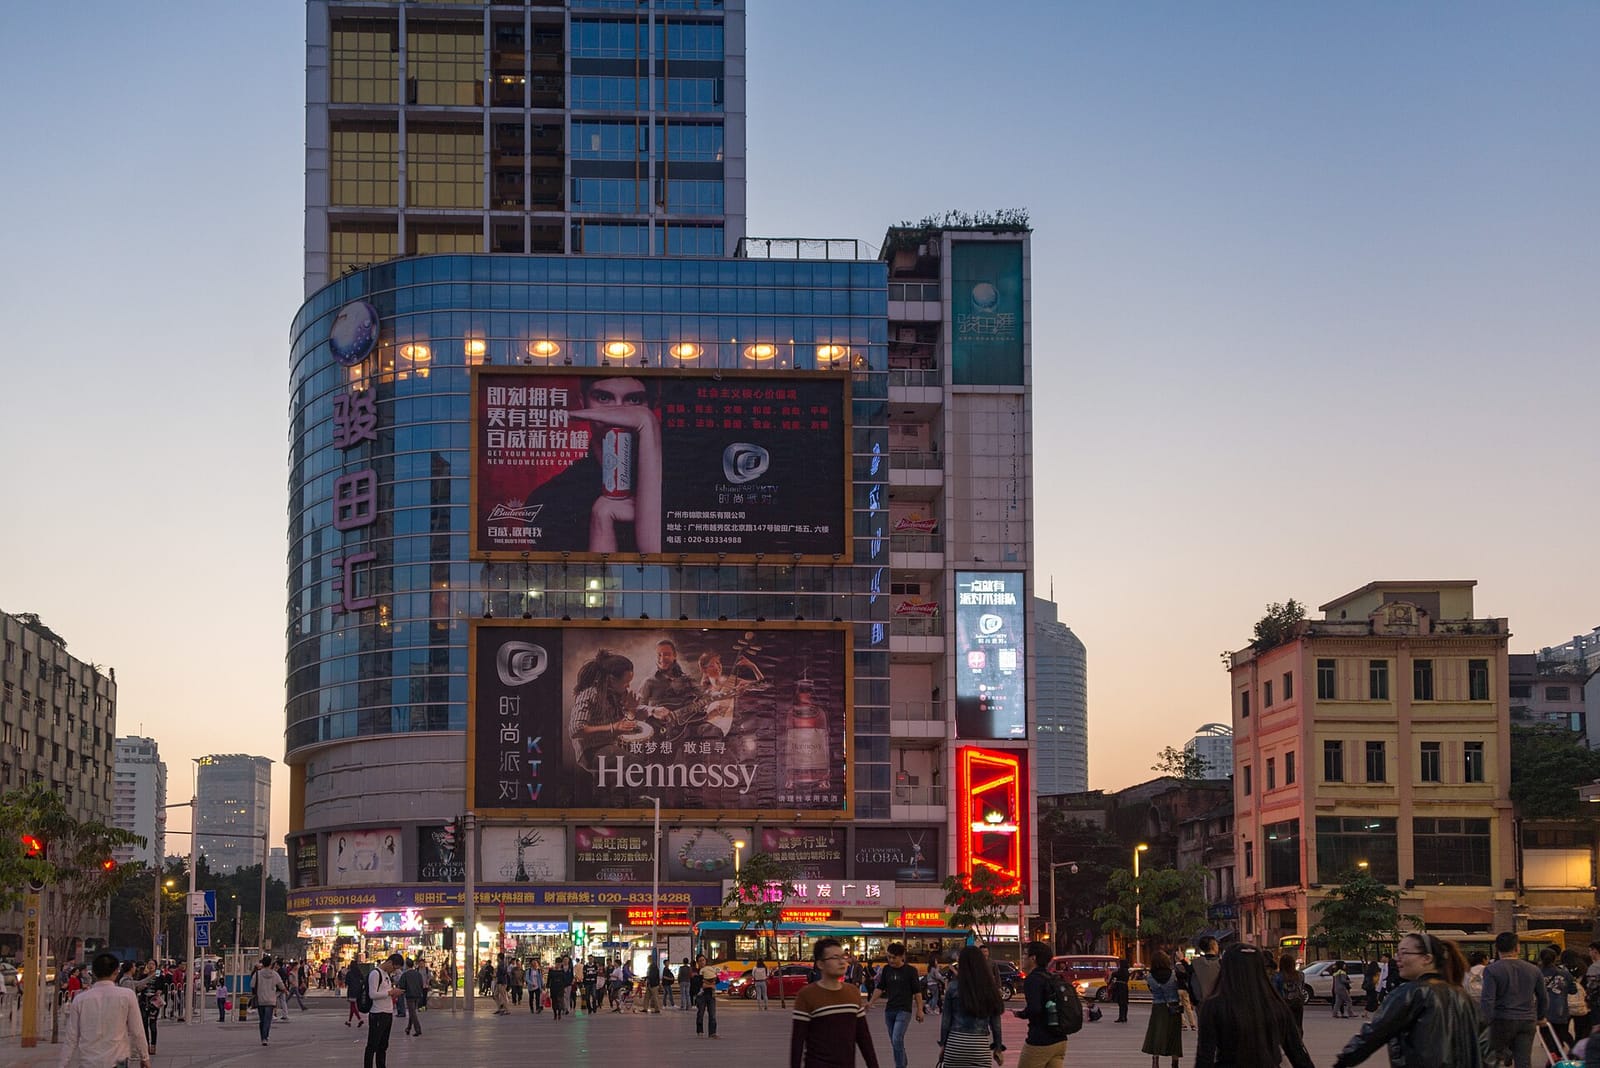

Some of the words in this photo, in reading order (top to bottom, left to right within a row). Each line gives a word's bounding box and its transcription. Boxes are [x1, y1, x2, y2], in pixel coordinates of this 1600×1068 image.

[487, 386, 569, 407] 即刻拥有
[487, 407, 569, 428] 更有型的
[486, 428, 589, 450] 百威新锐罐
[332, 387, 377, 614] 骏田汇
[493, 506, 537, 518] Budweiser
[499, 695, 521, 801] 时尚派对
[629, 741, 673, 755] 敢梦想
[683, 741, 727, 755] 敢追寻
[527, 736, 543, 801] KTV
[597, 755, 759, 794] Hennessy
[855, 853, 908, 864] GLOBAL
[422, 867, 465, 878] GLOBA
[596, 872, 637, 881] GLOBAL
[598, 892, 691, 903] 020-8334288
